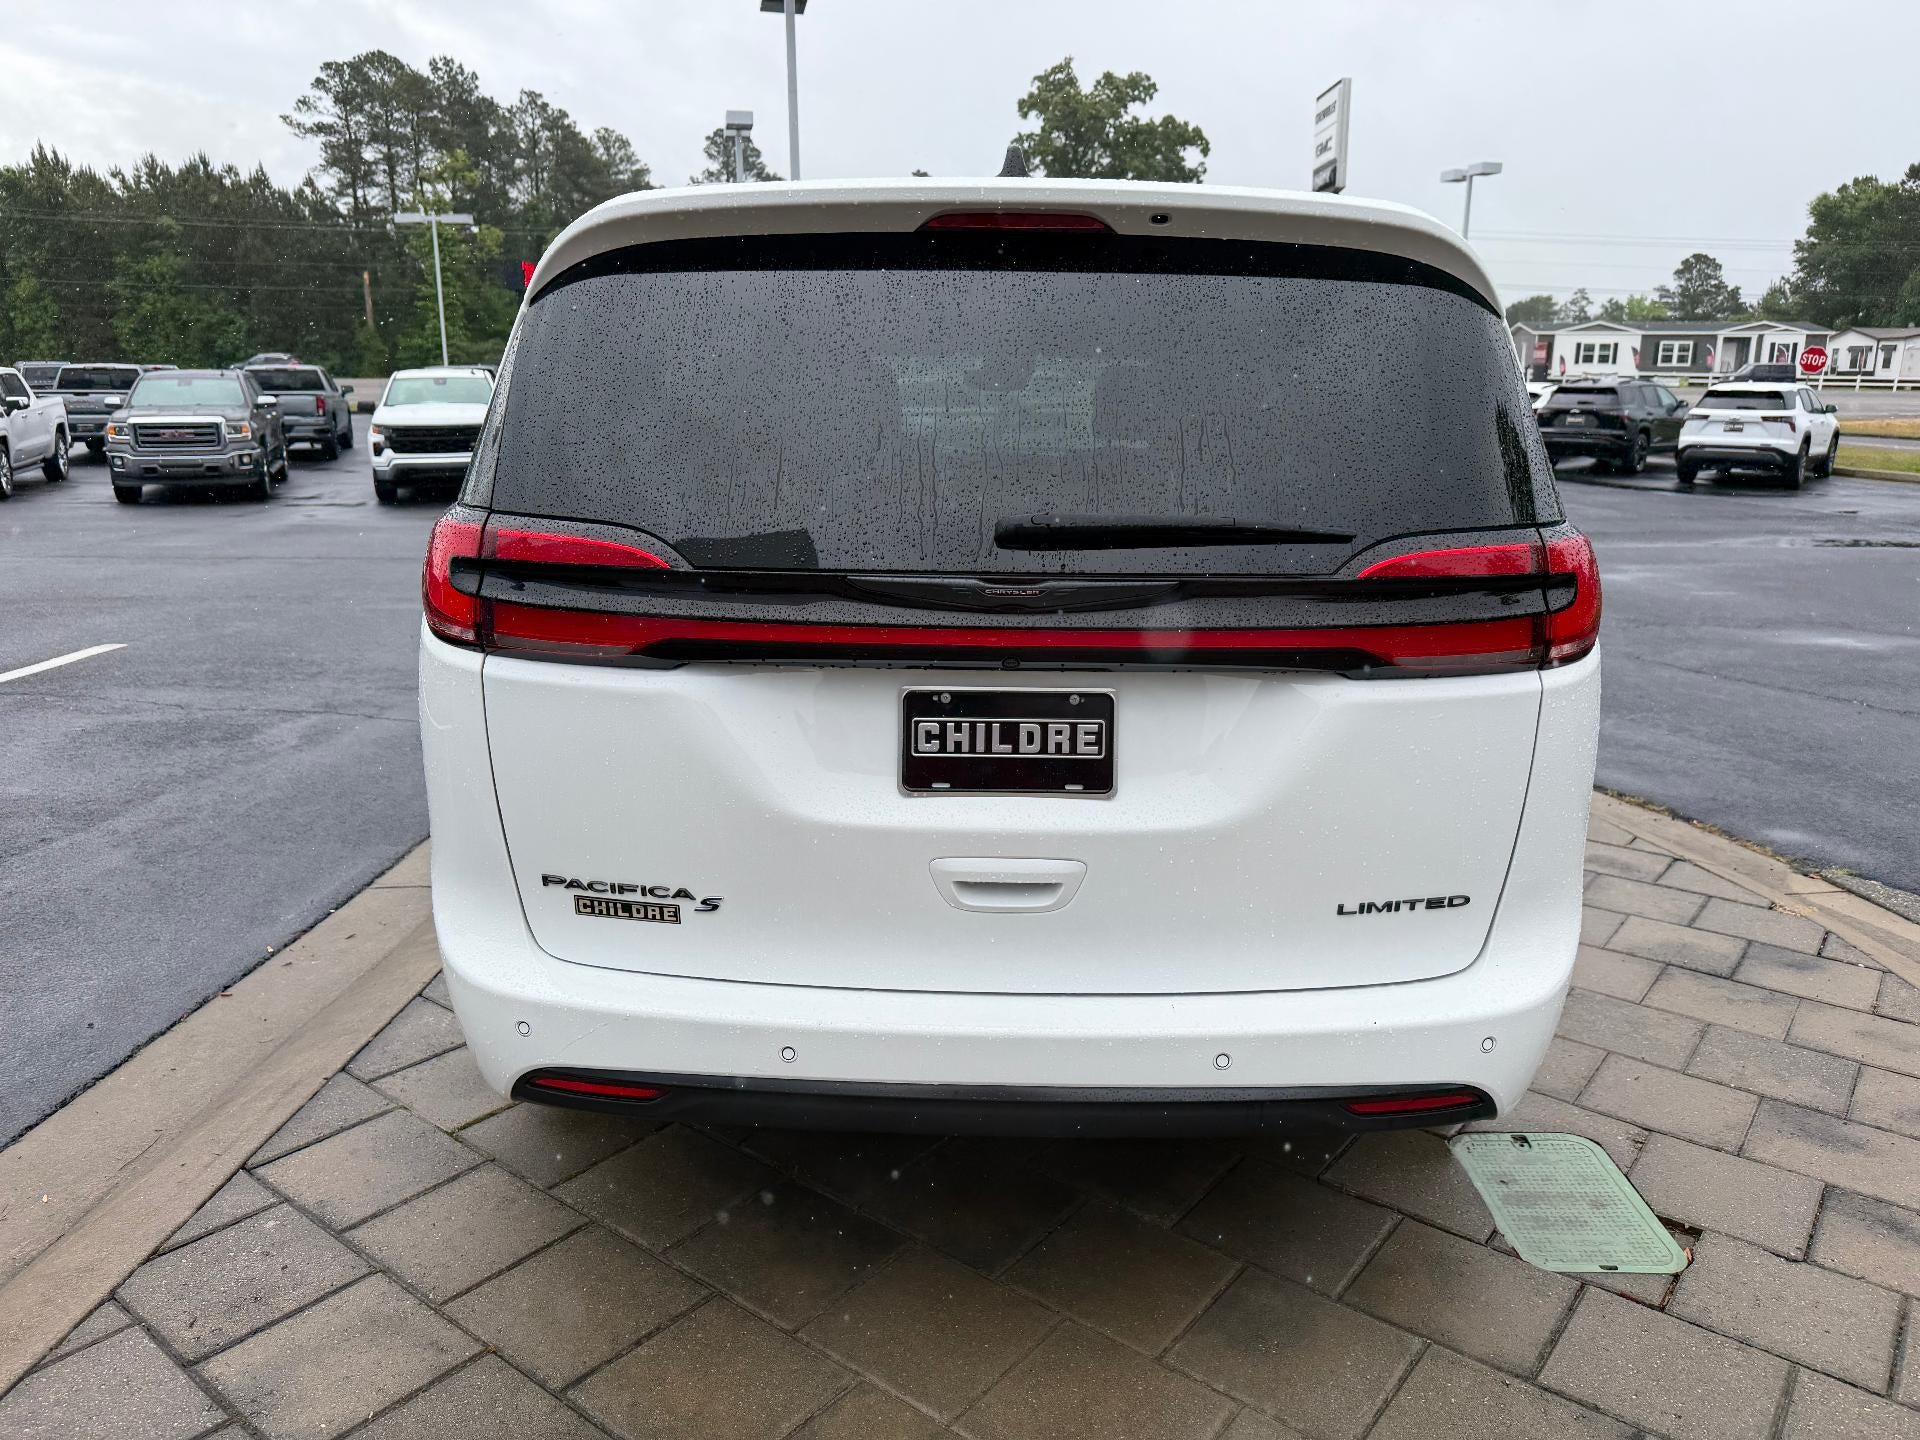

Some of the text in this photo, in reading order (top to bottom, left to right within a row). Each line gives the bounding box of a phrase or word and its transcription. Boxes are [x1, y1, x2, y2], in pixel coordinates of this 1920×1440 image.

[1801, 353, 1826, 366] STOP
[917, 722, 1099, 754] CHILDRE
[541, 873, 724, 912] PACIFICA S
[578, 899, 677, 921] CHILDRE
[1336, 894, 1471, 916] LIMITED
